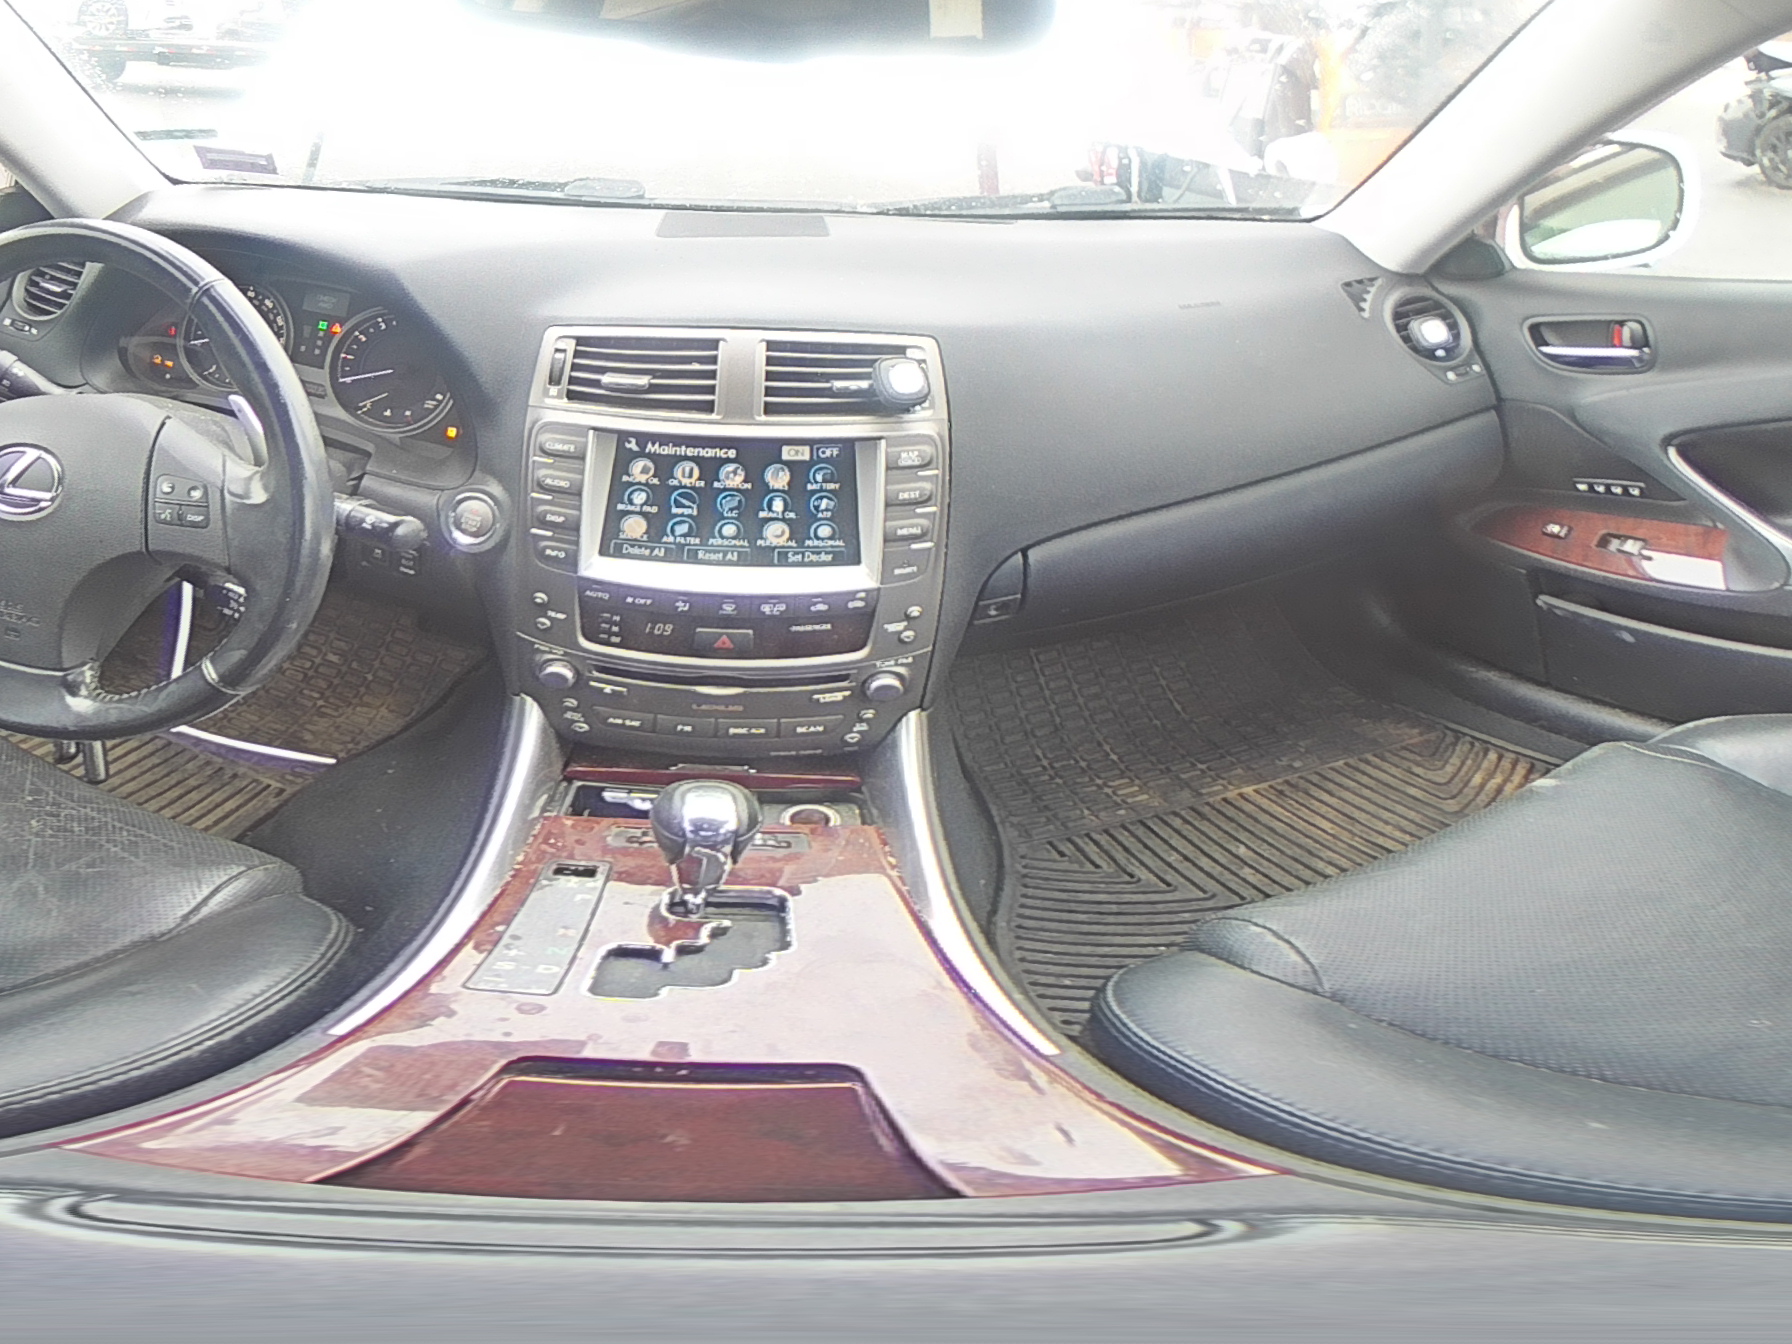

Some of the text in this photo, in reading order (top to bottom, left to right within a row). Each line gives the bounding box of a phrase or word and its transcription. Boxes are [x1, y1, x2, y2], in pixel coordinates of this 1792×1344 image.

[645, 440, 737, 458] Maintenance
[787, 447, 805, 457] ON
[818, 448, 840, 458] OFF
[584, 589, 611, 601] AUTO
